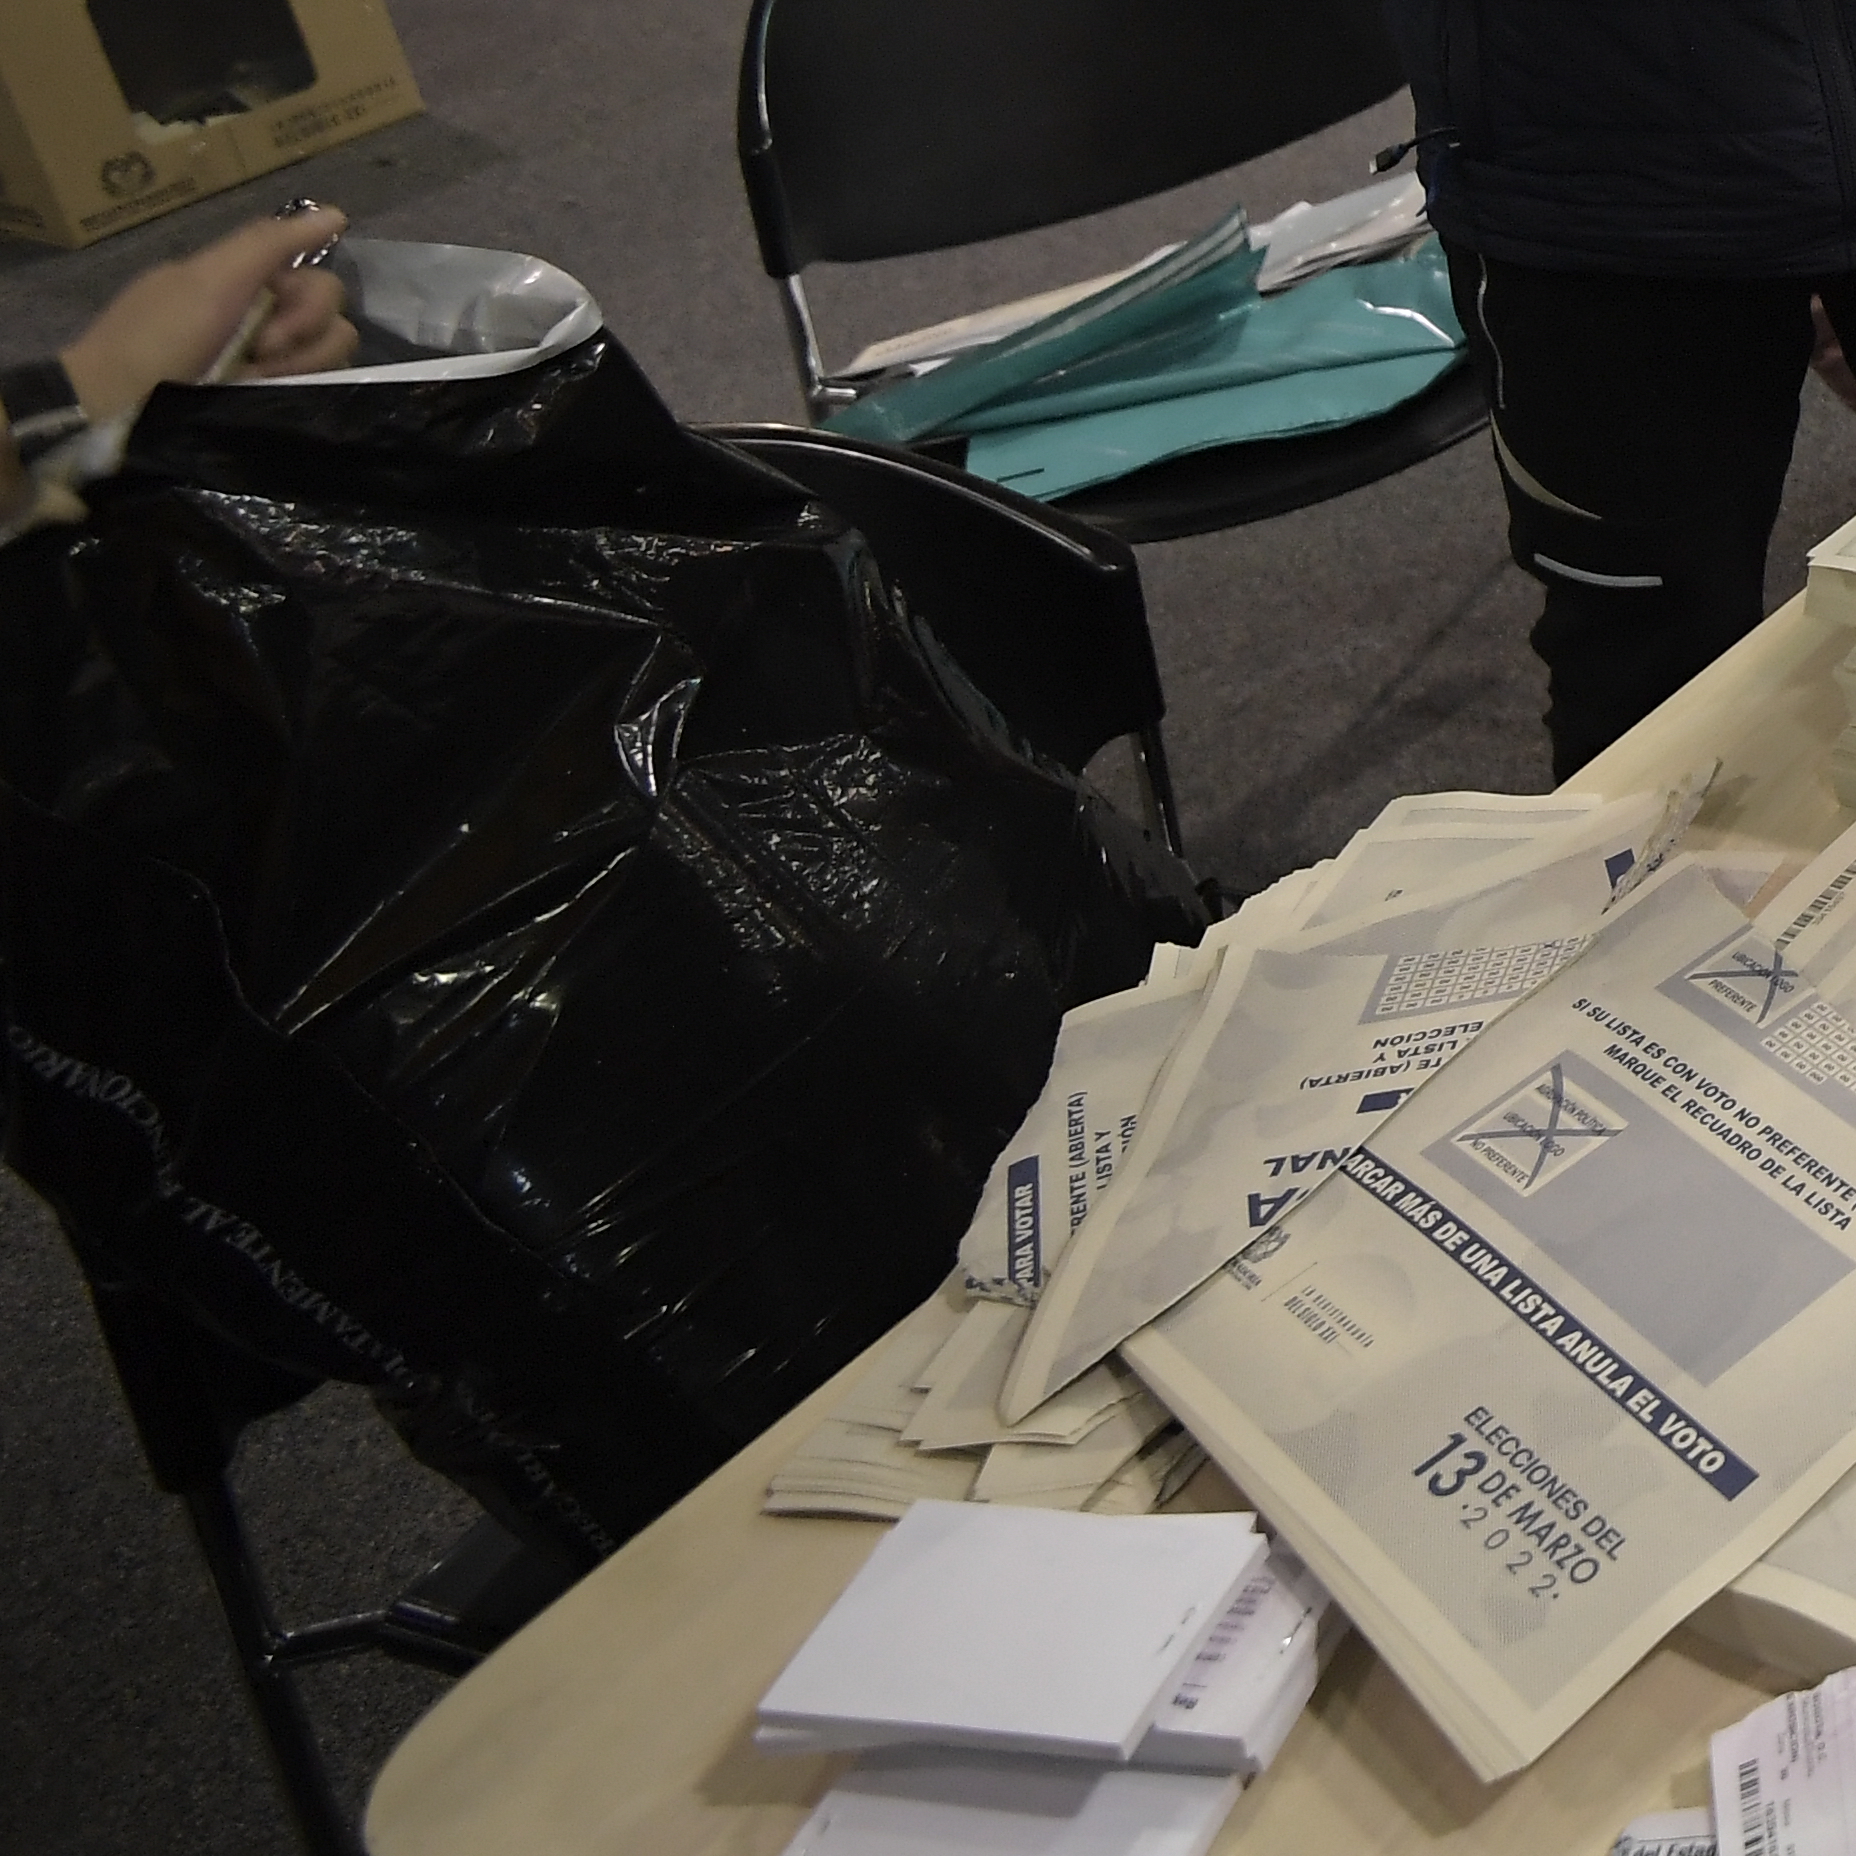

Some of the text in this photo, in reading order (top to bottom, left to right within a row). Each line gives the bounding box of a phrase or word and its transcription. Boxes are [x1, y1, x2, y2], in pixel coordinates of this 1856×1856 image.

[1372, 1020, 1483, 1049] ELECCIÓN
[1372, 1038, 1458, 1063] LISTA Y
[1299, 1060, 1410, 1090] (ABIERTA)
[1068, 1090, 1089, 1176] (ABIERTA)
[1096, 1131, 1108, 1147] Y
[1014, 1183, 1033, 1232] VOTAR
[1391, 1190, 1447, 1229] MÁS
[1430, 1222, 1469, 1250] DE
[1457, 1243, 1510, 1284] UNA
[1497, 1280, 1566, 1335] LISTA
[1555, 1329, 1636, 1393] ANULA
[1625, 1390, 1666, 1420] EL
[1656, 1416, 1728, 1473] VOTO
[1461, 1407, 1632, 1560] ELECCIONES DEL
[1409, 1435, 1604, 1583] 13 DE MARZO
